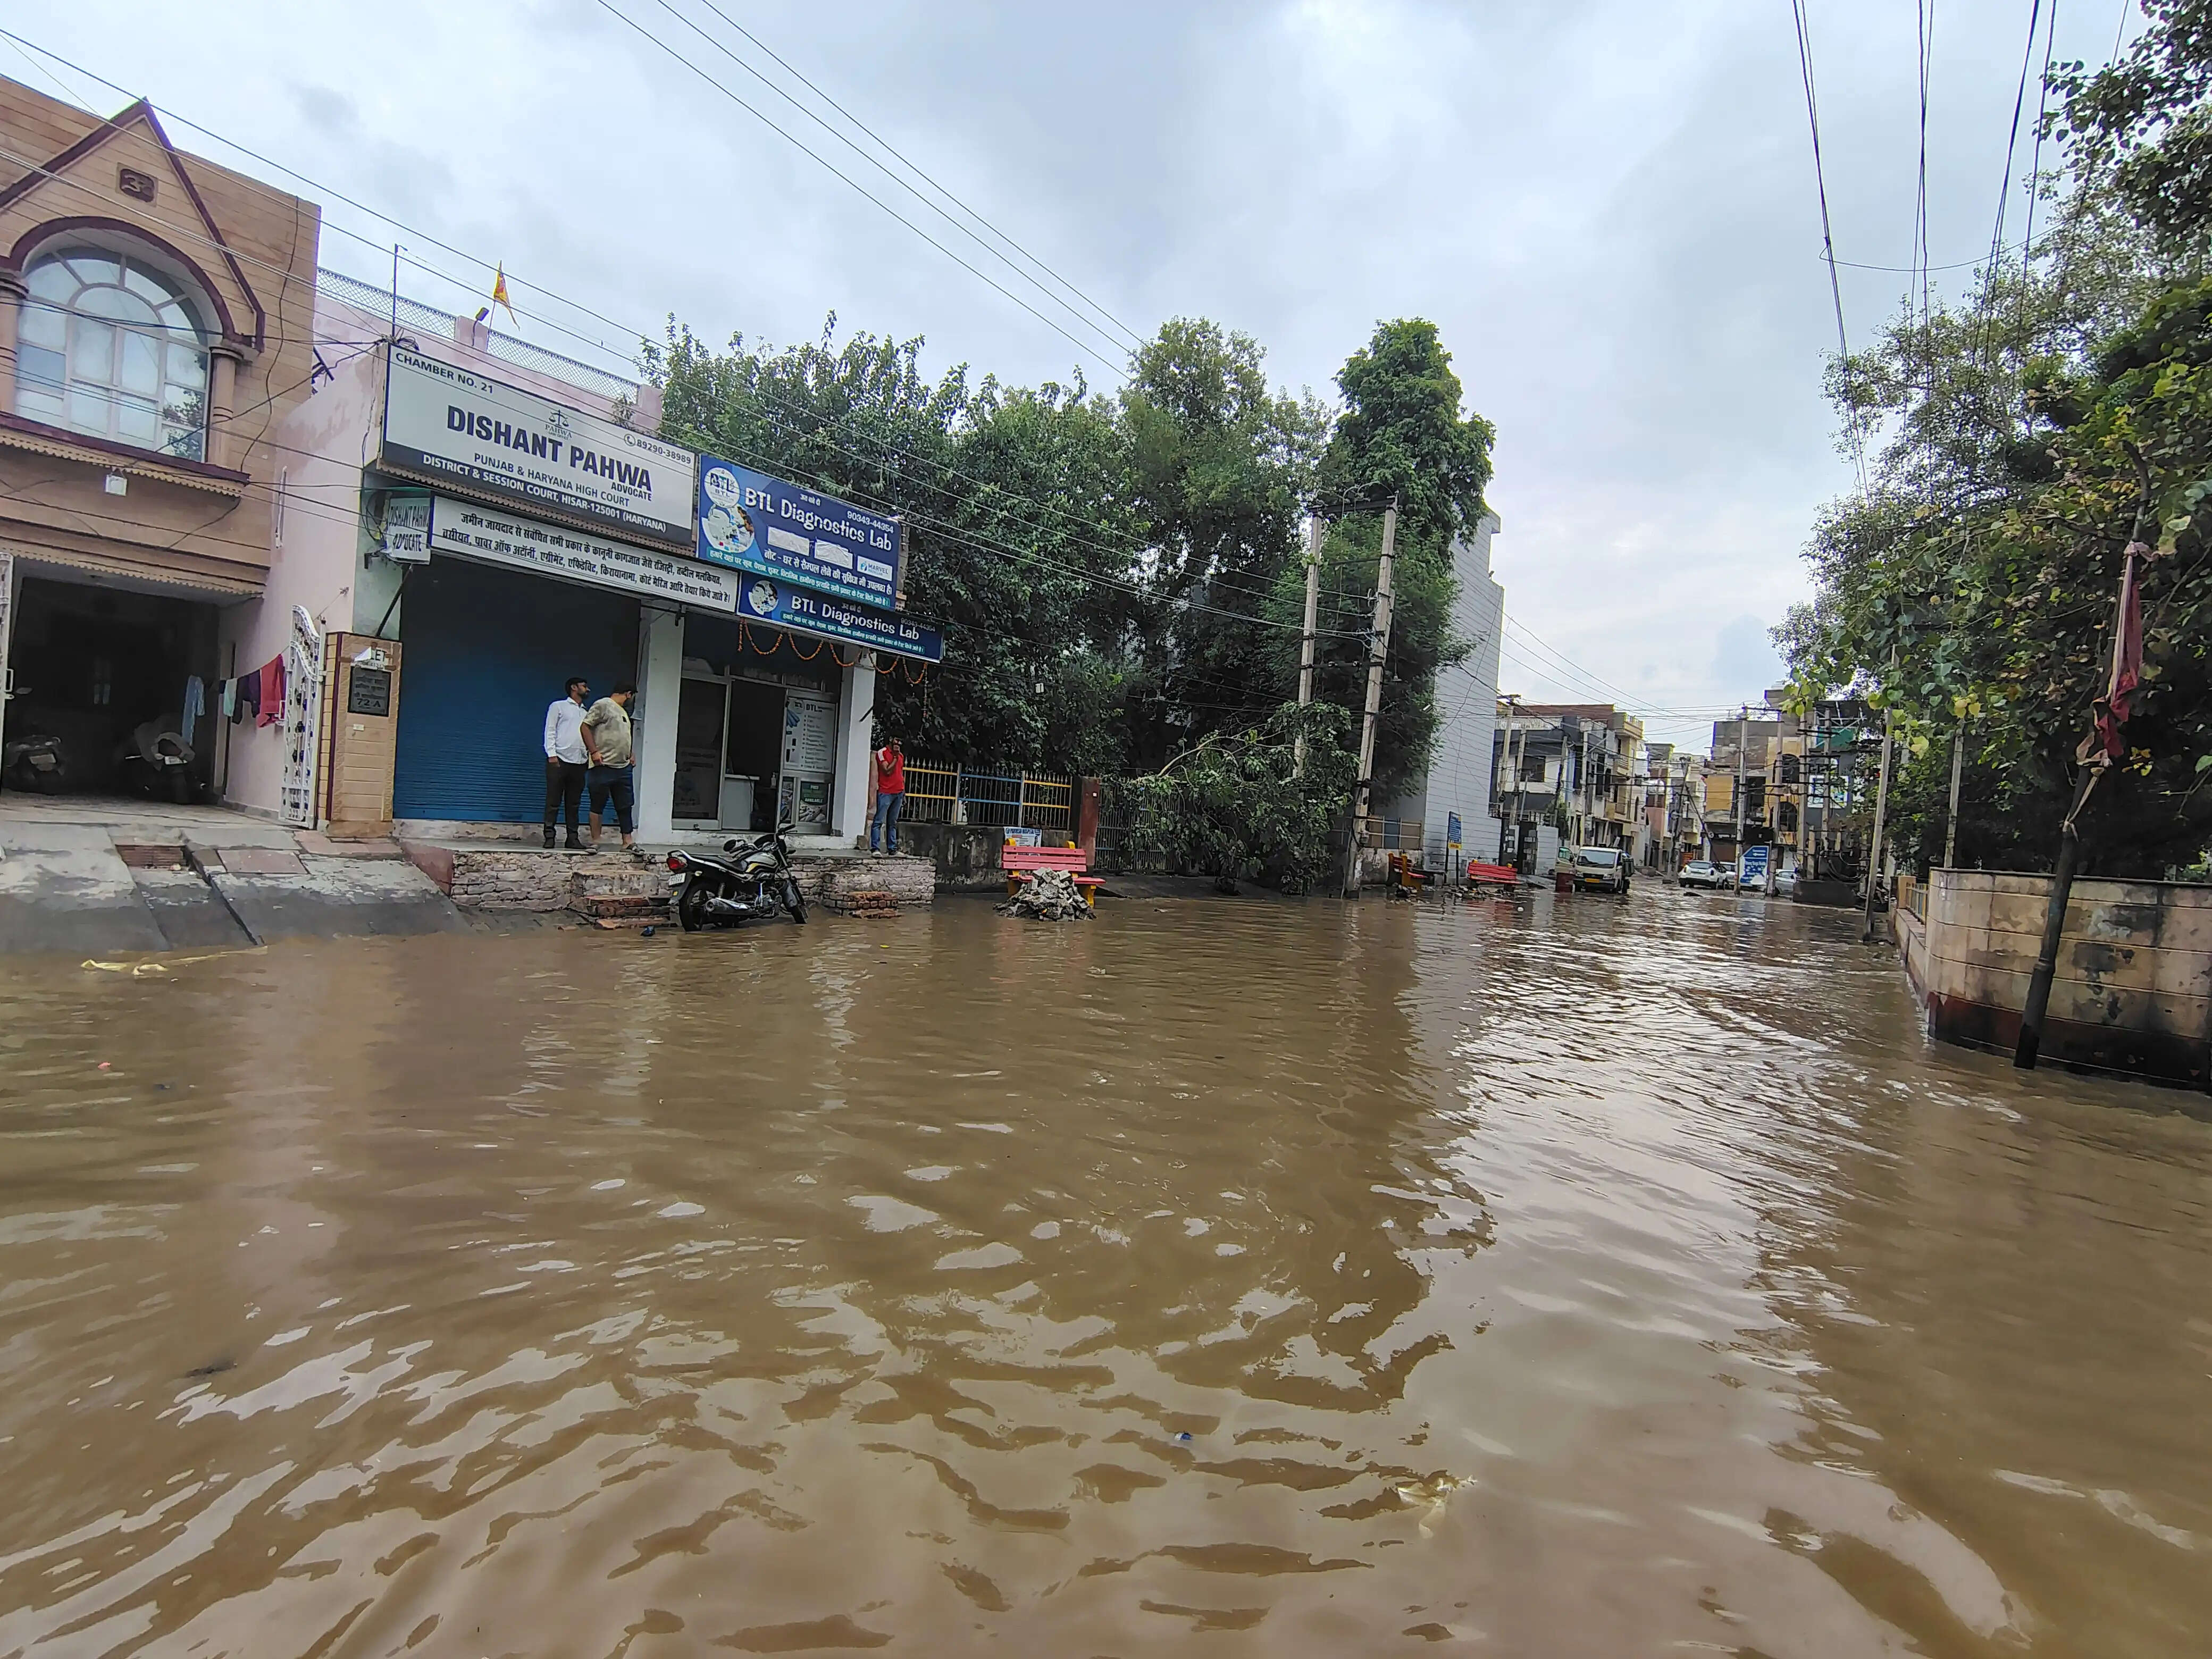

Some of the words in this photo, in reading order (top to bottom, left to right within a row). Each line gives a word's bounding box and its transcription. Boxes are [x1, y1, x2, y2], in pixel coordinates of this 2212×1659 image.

[396, 353, 454, 380] CHAMBER
[458, 374, 477, 388] NO.
[481, 382, 493, 393] 21
[447, 405, 563, 463] DISHANT
[570, 445, 652, 492] PAHWA
[545, 424, 572, 439] PAHWA
[637, 439, 691, 464] 89290-38989
[423, 454, 470, 476] DISTRICT
[472, 468, 480, 479] &
[483, 471, 524, 492] SESSION
[526, 483, 559, 502] COURT,
[562, 494, 620, 518] HISAR-125001
[623, 511, 666, 533] (HARYANA)
[474, 453, 514, 473] PUNJAB
[517, 466, 524, 476] &
[527, 468, 573, 491] HARYANA
[576, 483, 598, 498] HIGH
[601, 491, 630, 507] COURT
[611, 482, 652, 501] ADVOCATE
[744, 487, 775, 514] BTL
[781, 499, 865, 542] Diagnostics
[869, 529, 892, 551] Lab
[847, 510, 894, 533] 90343-44354
[392, 533, 422, 551] ADVOCATE
[460, 513, 484, 527] जमीन
[485, 519, 514, 535] जायदाद
[515, 524, 522, 537] से
[524, 527, 548, 543] संबंधित
[549, 535, 564, 547] सभी
[565, 539, 583, 552] प्रकार
[584, 542, 591, 553] के
[592, 546, 613, 561] कानूनी
[614, 551, 640, 566] कागजात
[641, 556, 652, 569] जैसे
[676, 566, 694, 579] तब्दील
[710, 550, 723, 559] हमारे
[734, 557, 742, 565] पर
[474, 536, 493, 549] पावर
[494, 539, 512, 553] ऑफ
[639, 573, 651, 584] कोर्ट
[652, 576, 668, 589] मैरिज
[669, 581, 683, 592] आदि
[684, 582, 698, 596] तैयार
[699, 586, 711, 599] किये
[712, 591, 723, 601] जाते
[764, 549, 776, 560] नोट
[783, 555, 792, 566] घर
[793, 557, 799, 568] से
[801, 558, 819, 574] सैम्पल
[820, 565, 831, 577] लेने
[833, 569, 841, 580] की
[842, 572, 858, 585] सुविधा
[859, 576, 866, 588] भी
[867, 580, 885, 593] उपलब्ध
[868, 563, 889, 574] MARVEL
[791, 596, 816, 614] BTL
[822, 604, 895, 634] Diagnostics
[900, 624, 919, 640] Lab
[900, 617, 936, 632] 90343-44354
